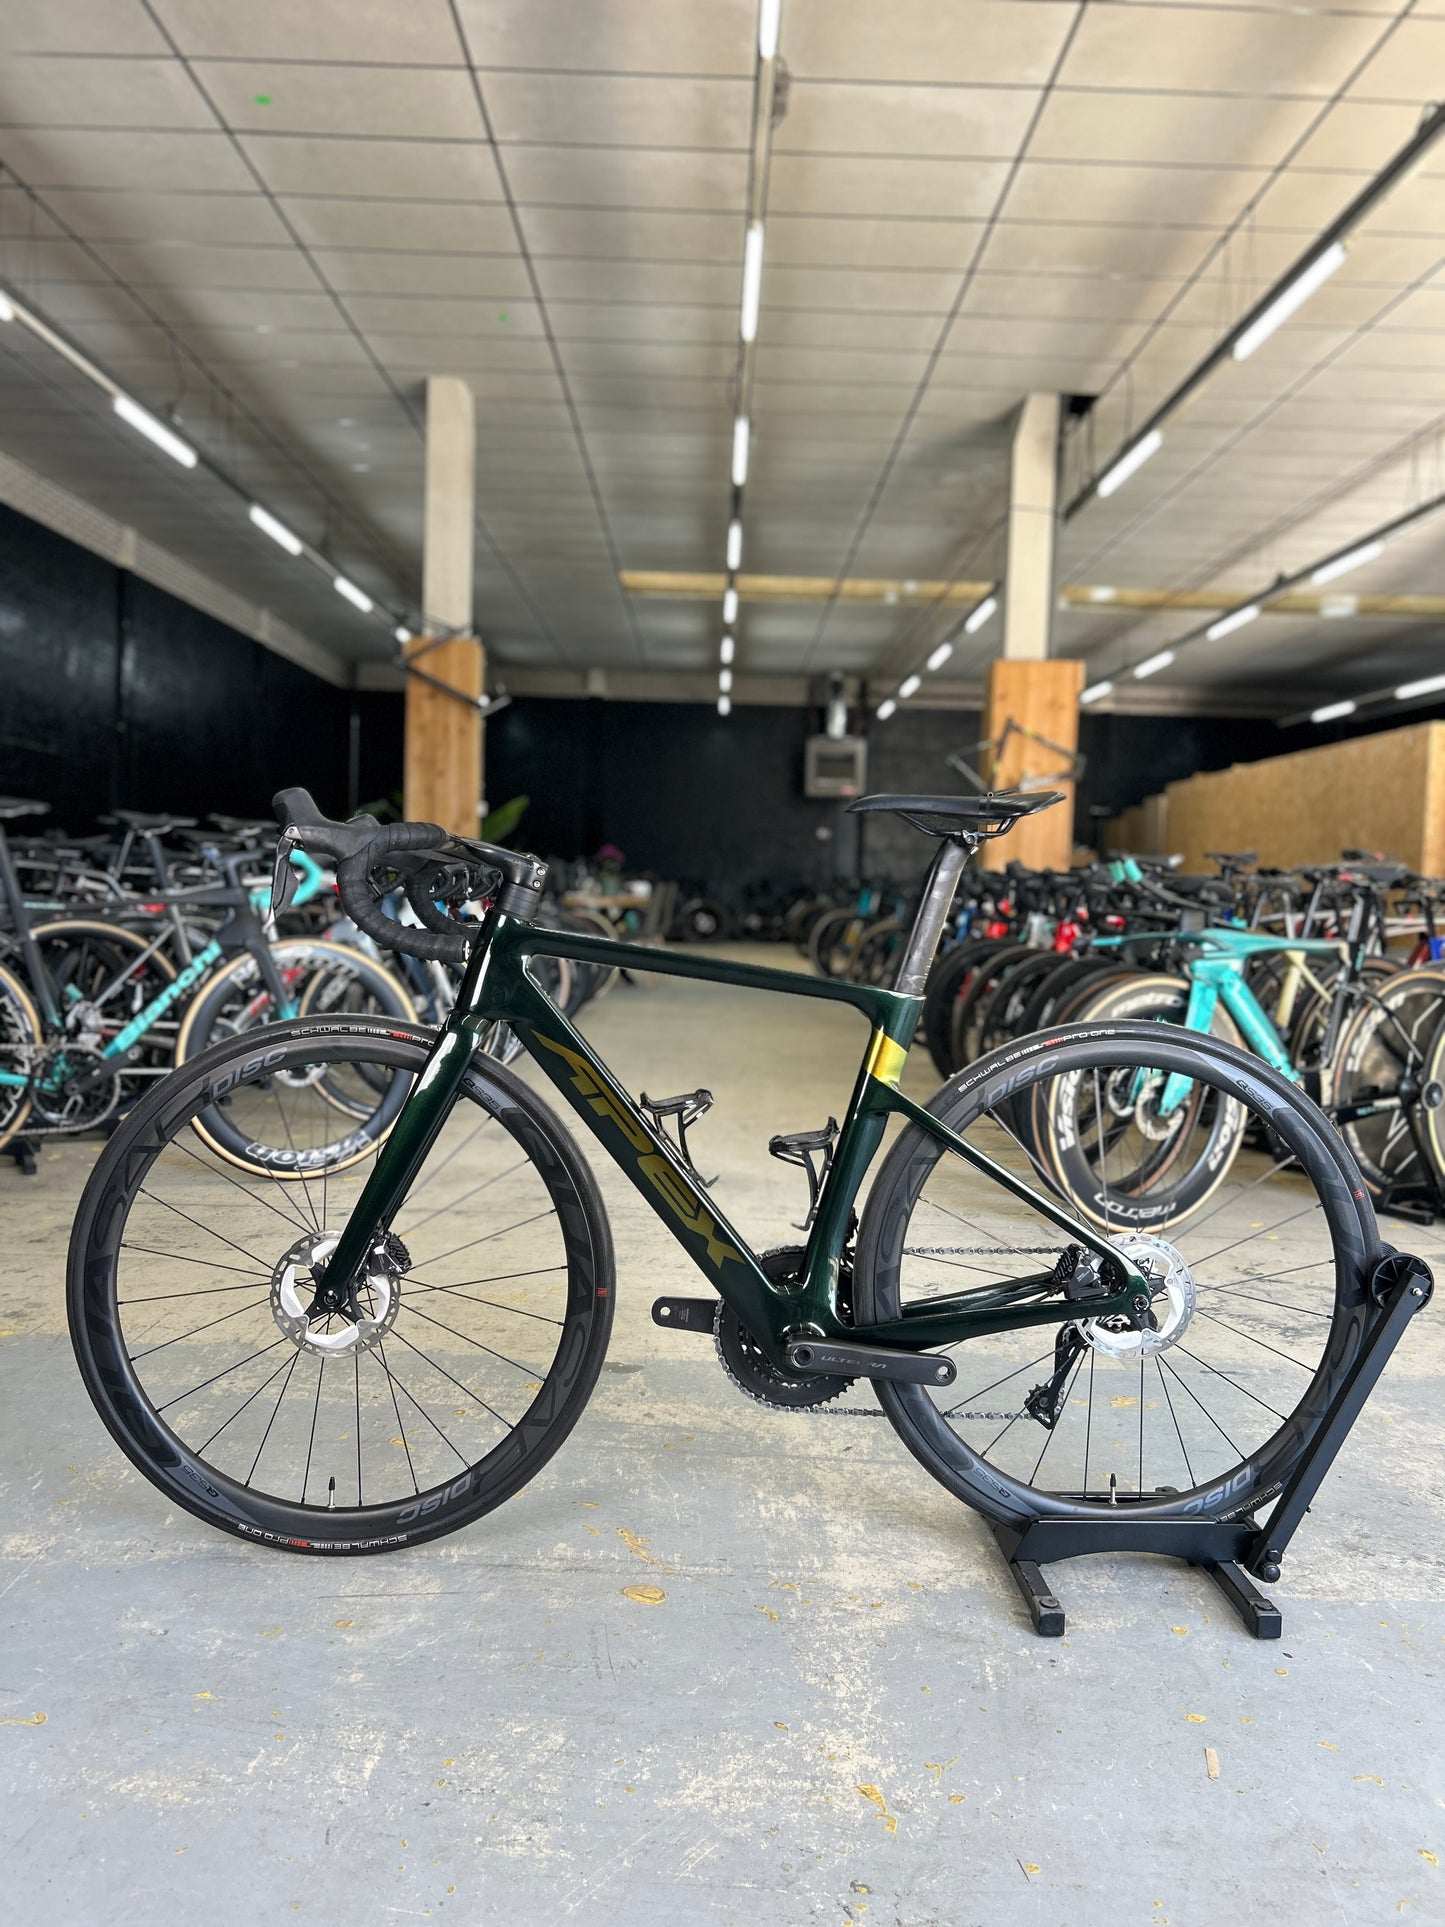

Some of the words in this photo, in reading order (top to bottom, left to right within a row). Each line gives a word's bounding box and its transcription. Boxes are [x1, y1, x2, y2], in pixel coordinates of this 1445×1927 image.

[291, 1024, 366, 1037] SCHWALBE
[212, 1047, 288, 1099] DISC
[958, 1051, 1023, 1093] SCHWALBE
[987, 1055, 1059, 1107] DISC
[463, 1077, 501, 1110] QS35
[1235, 1079, 1274, 1110] QS35
[531, 1029, 746, 1270] APEX
[181, 1465, 219, 1497] QS35
[396, 1472, 473, 1525] DISC
[974, 1467, 1011, 1498] QS35
[1184, 1464, 1251, 1515] DISC
[1220, 1482, 1283, 1522] SCHWALBE
[333, 1534, 407, 1550] SCHWALBE
